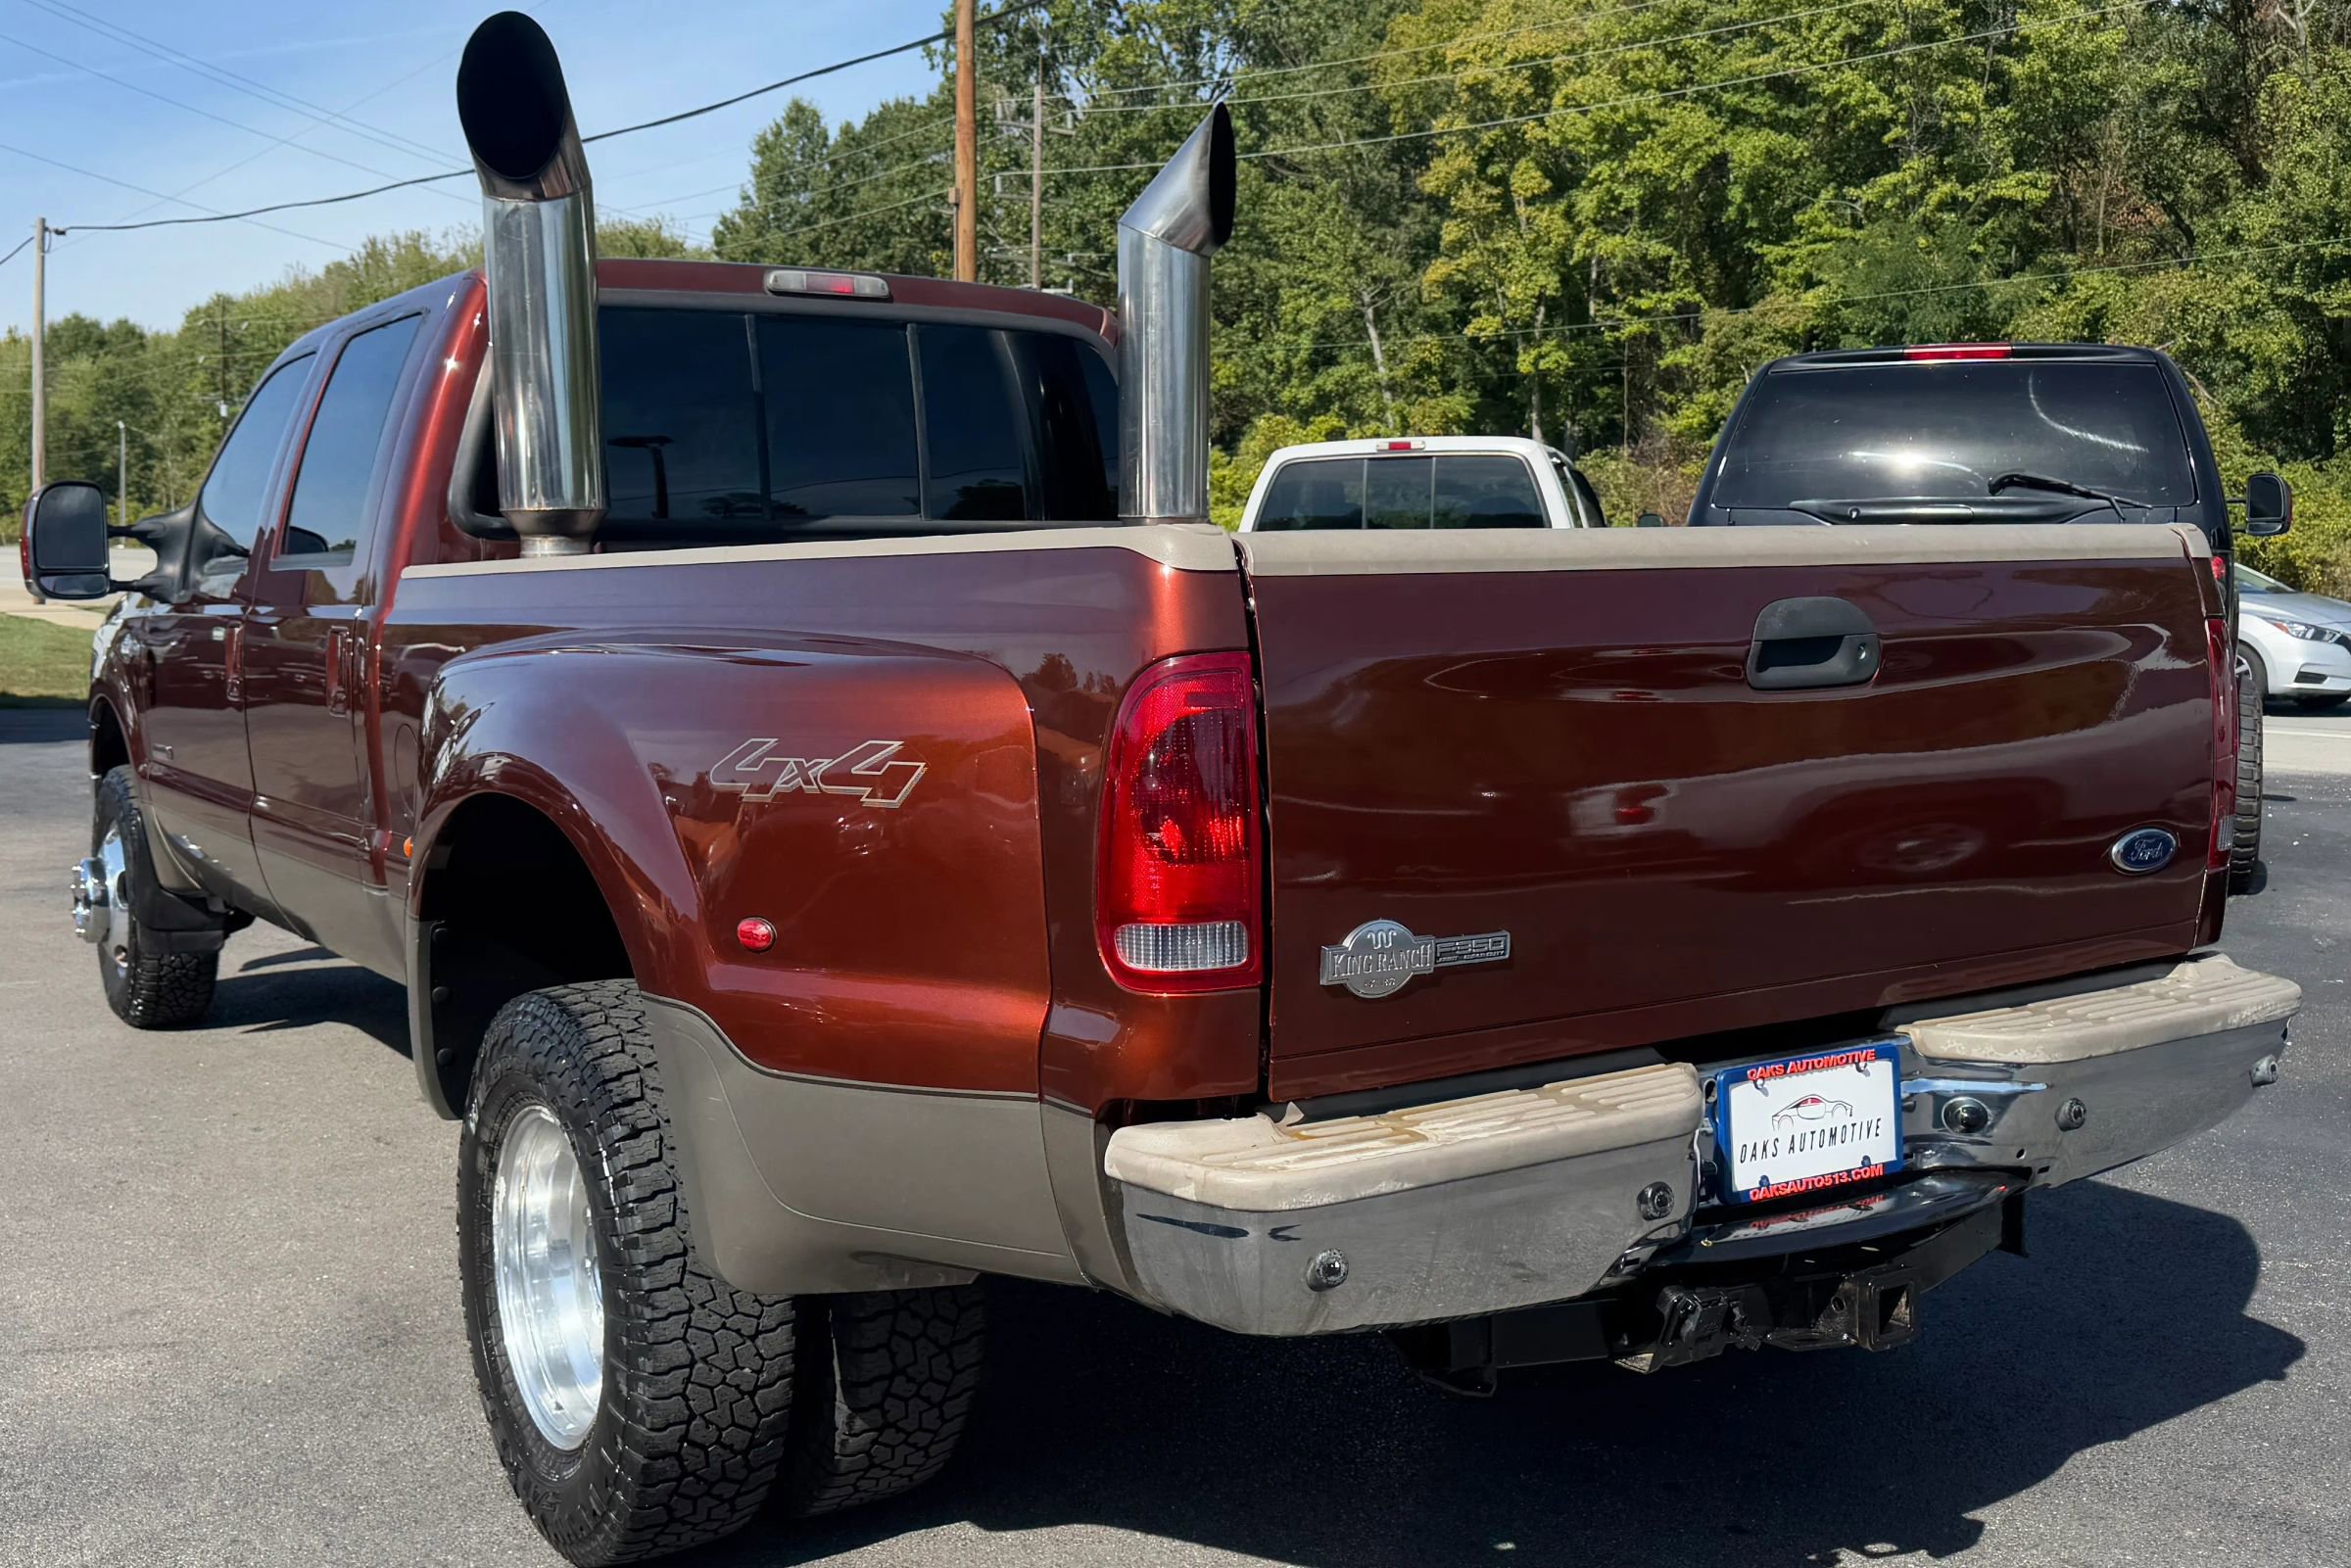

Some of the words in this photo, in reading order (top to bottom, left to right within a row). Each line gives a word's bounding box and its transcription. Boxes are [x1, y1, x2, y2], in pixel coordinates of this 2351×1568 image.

[710, 738, 928, 808] 4x4
[2129, 838, 2164, 862] Ford
[1333, 953, 1372, 977] KING
[1375, 943, 1431, 973] RANCH
[1748, 1063, 1785, 1081] OAKS
[1787, 1049, 1876, 1074] AUTOMOTIVE
[1740, 1137, 1780, 1164] OAKS
[1788, 1117, 1882, 1155] AUTOMOTIVE
[1750, 1164, 1884, 1201] OAKSAUTO513.COM
